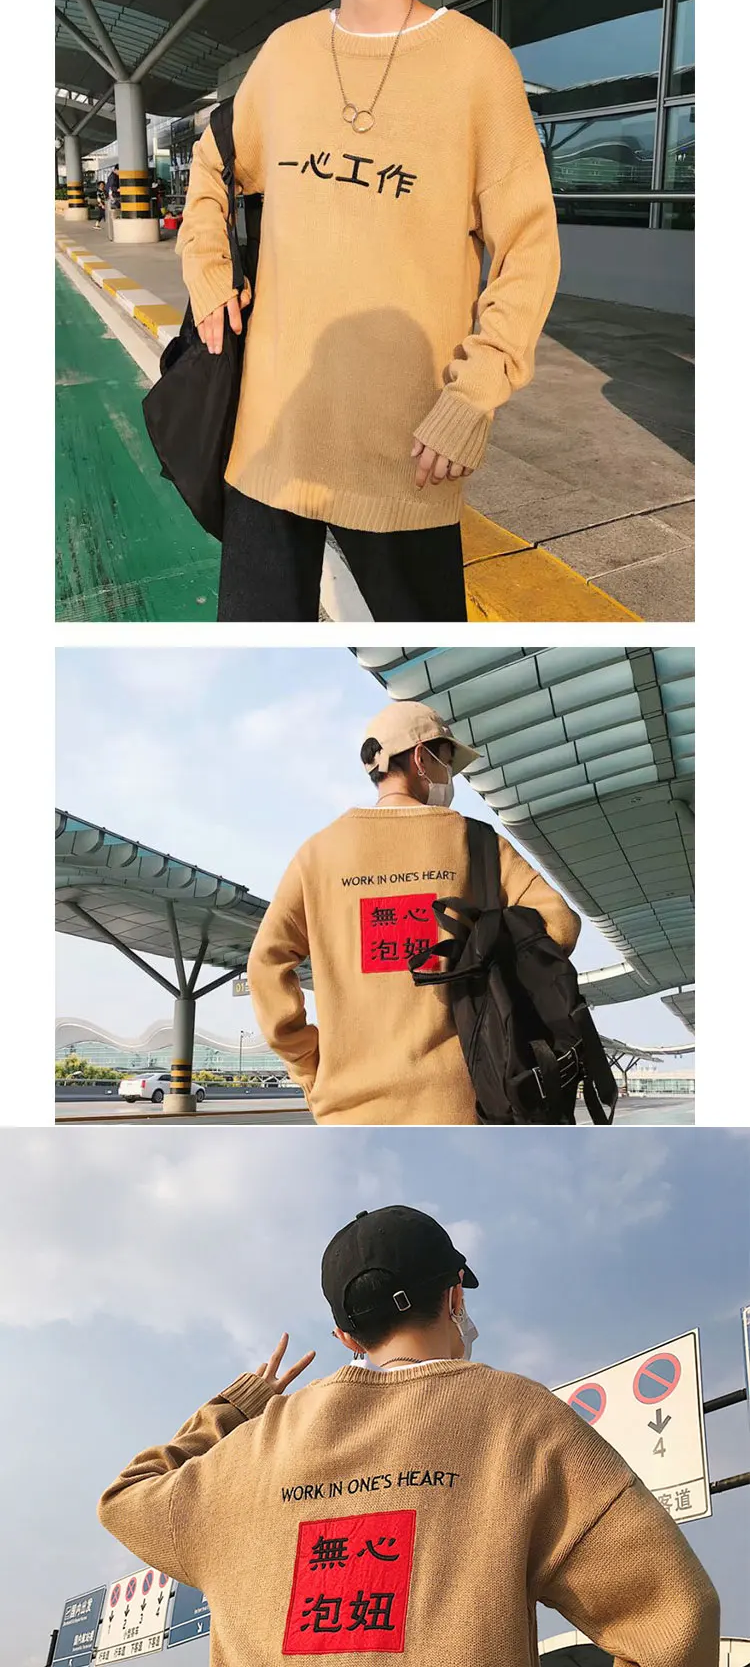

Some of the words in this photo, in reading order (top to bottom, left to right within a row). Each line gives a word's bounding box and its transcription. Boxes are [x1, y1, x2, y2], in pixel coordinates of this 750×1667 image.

[278, 151, 418, 199] 一心工作
[341, 875, 375, 887] WORK
[377, 874, 387, 885] IN
[389, 872, 420, 884] ONE'S
[422, 870, 457, 881] HEART
[371, 906, 430, 927] 無心
[652, 1436, 667, 1458] 4
[282, 1483, 325, 1503] WORK
[328, 1481, 343, 1498] IN
[347, 1473, 392, 1495] ONE'S
[397, 1470, 460, 1488] HEART
[309, 1535, 400, 1571] 無心
[300, 1590, 396, 1633] 泡妞
